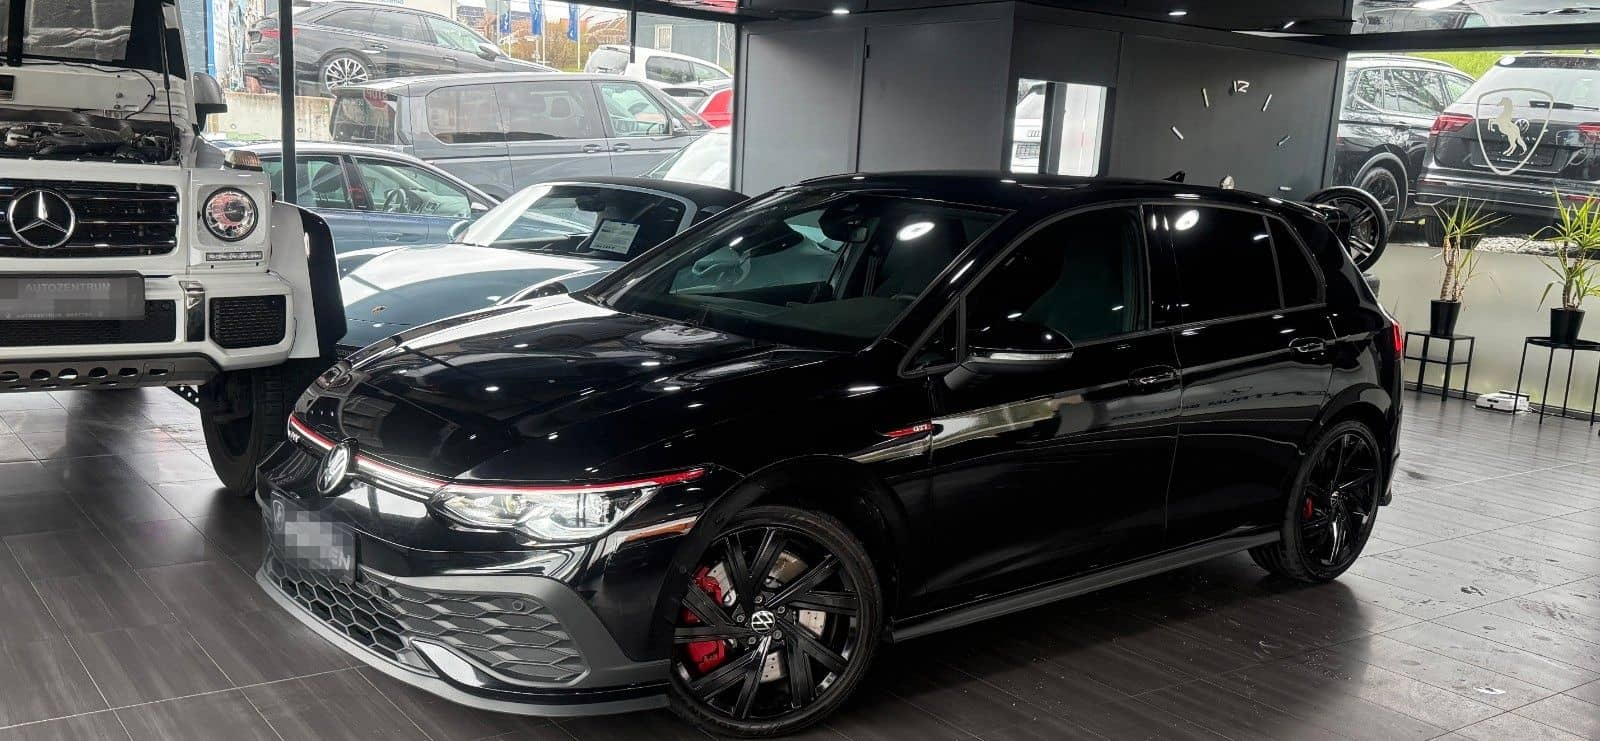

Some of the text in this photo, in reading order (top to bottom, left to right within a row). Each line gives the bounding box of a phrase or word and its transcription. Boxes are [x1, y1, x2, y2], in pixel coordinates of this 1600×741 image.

[1233, 80, 1250, 93] 12
[25, 281, 111, 293] AUTOZENTRUM
[913, 423, 928, 432] GTI
